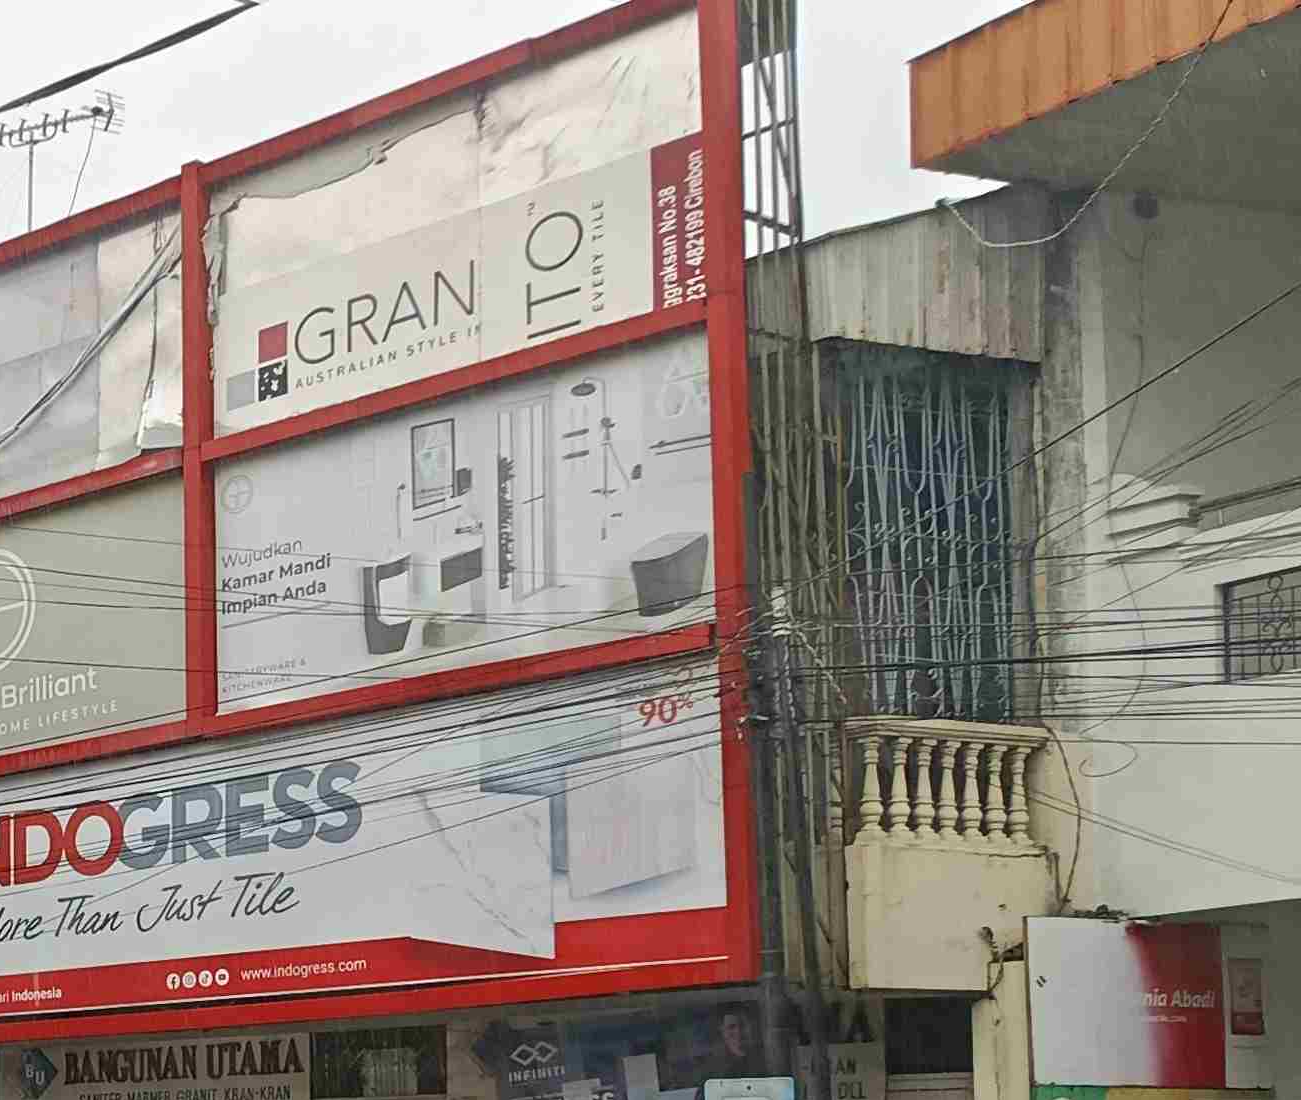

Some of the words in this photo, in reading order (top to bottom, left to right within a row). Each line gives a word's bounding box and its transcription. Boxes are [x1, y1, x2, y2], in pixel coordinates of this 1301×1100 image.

[657, 184, 677, 235] No.38
[684, 210, 706, 268] 482199
[294, 259, 475, 365] GRAN
[295, 350, 397, 389] AUSTRALIAN
[405, 332, 457, 358] STYLE
[221, 539, 302, 569] Wujudkan
[221, 569, 275, 593] Kamar
[278, 552, 332, 580] Mandi
[221, 592, 278, 615] Impian
[282, 580, 327, 601] Anda
[1, 666, 98, 709] Brilliant
[37, 700, 118, 728] LIFESTYLE
[57, 895, 122, 937] Than
[136, 878, 216, 934] Just
[229, 871, 301, 918] Tile
[240, 957, 367, 982] www.indogress.com
[11, 986, 62, 1002] Indonesia
[63, 1045, 197, 1086] BANGUNAN
[205, 1037, 306, 1080] UTAMA
